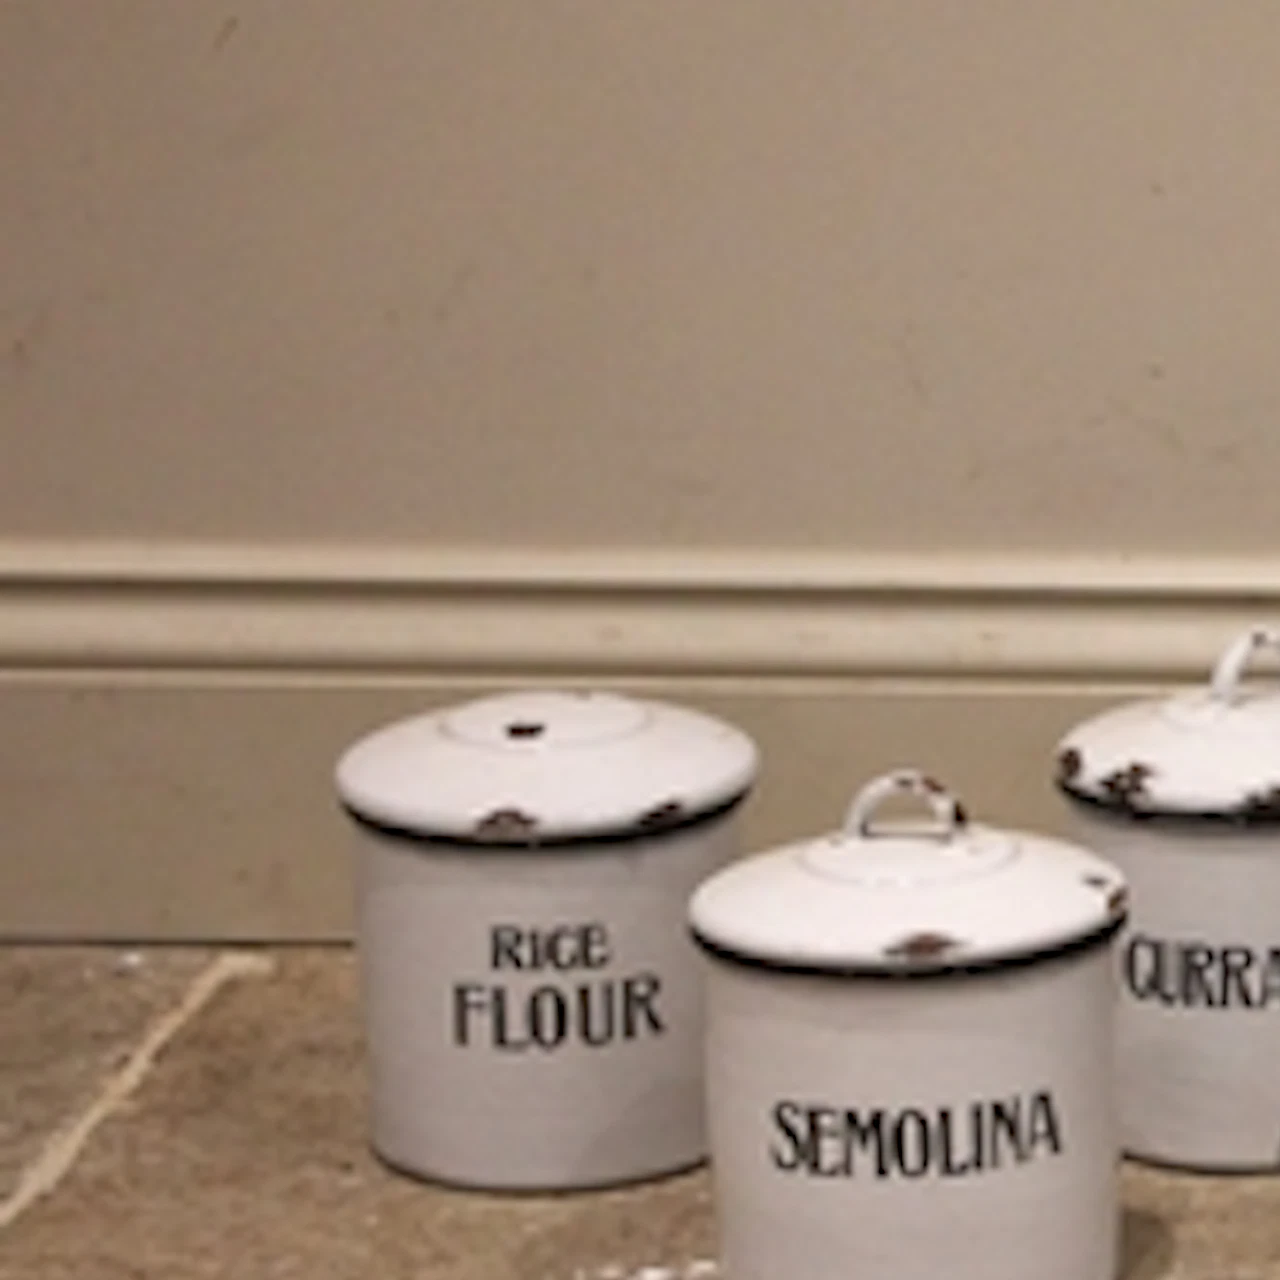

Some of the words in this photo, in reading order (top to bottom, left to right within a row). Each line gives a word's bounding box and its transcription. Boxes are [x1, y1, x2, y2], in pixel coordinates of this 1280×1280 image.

[488, 923, 610, 973] RICE
[451, 974, 666, 1051] FLOUR
[770, 1091, 1063, 1179] SEMOLINA
